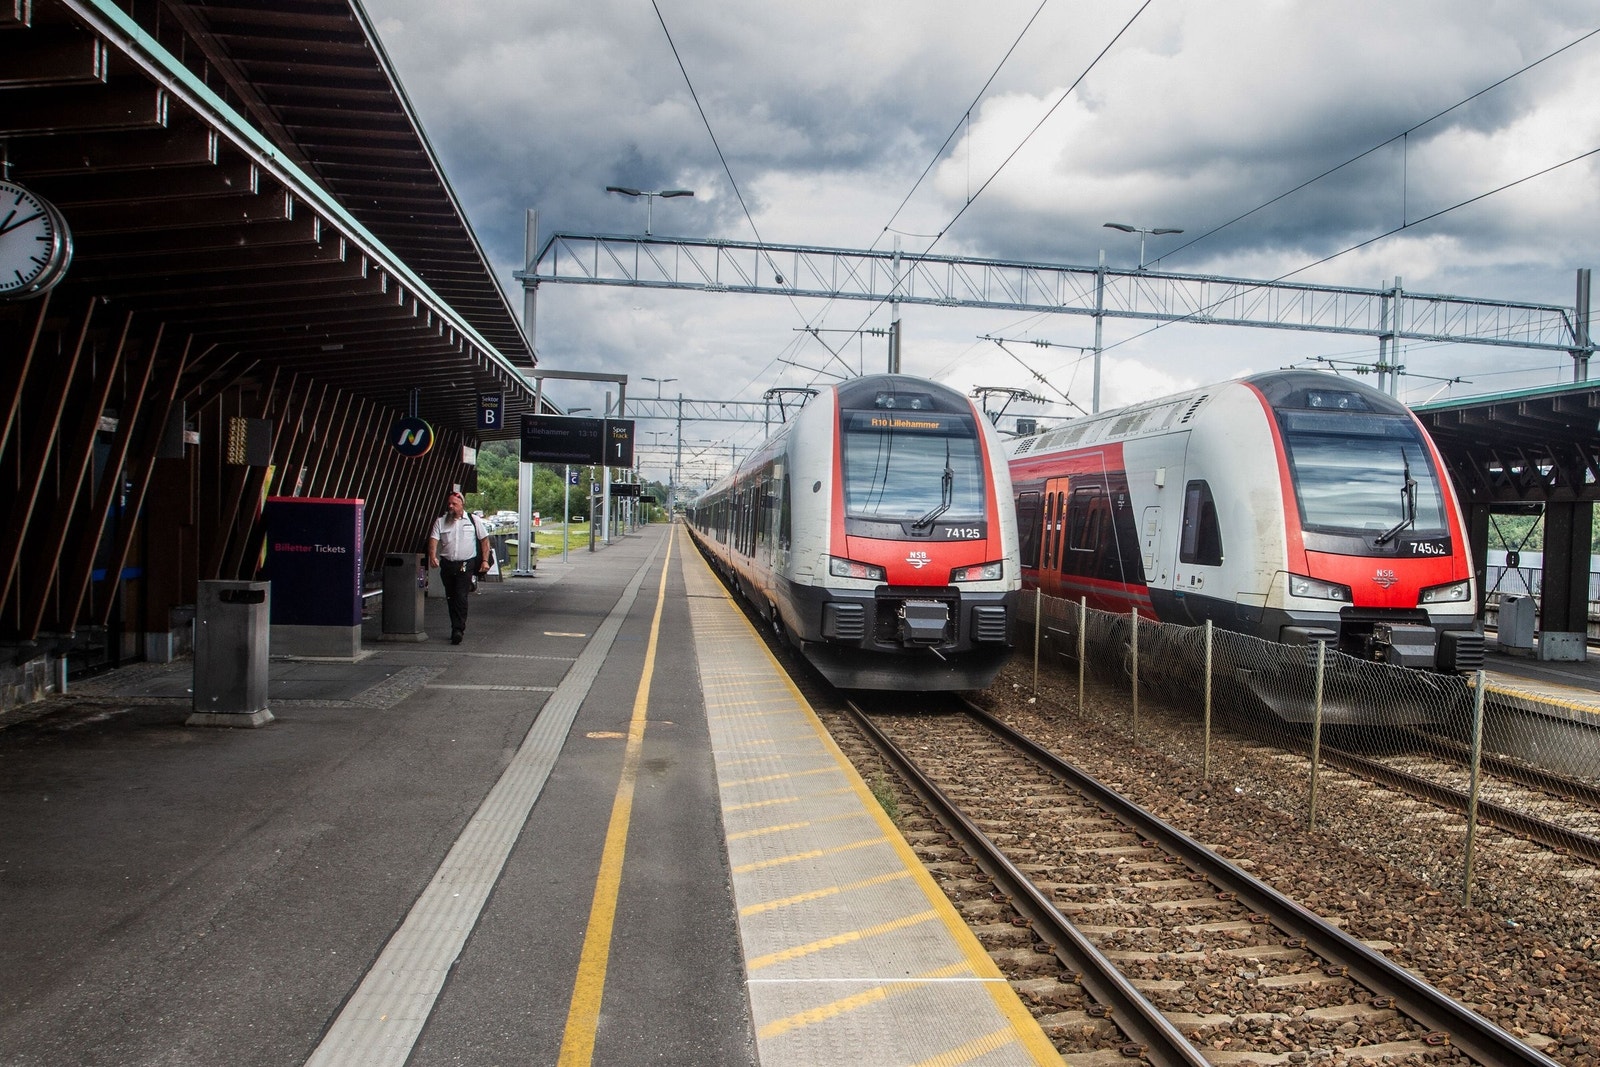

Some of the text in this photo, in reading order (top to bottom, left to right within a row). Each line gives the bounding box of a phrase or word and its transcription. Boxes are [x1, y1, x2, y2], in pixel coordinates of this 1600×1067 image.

[485, 409, 495, 423] B
[871, 418, 939, 429] R10 Lillehammer
[527, 428, 570, 436] Lillehammer
[615, 442, 621, 458] 1
[945, 528, 980, 538] 74125
[274, 543, 346, 553] Billetter Tickets
[909, 551, 927, 559] NSB
